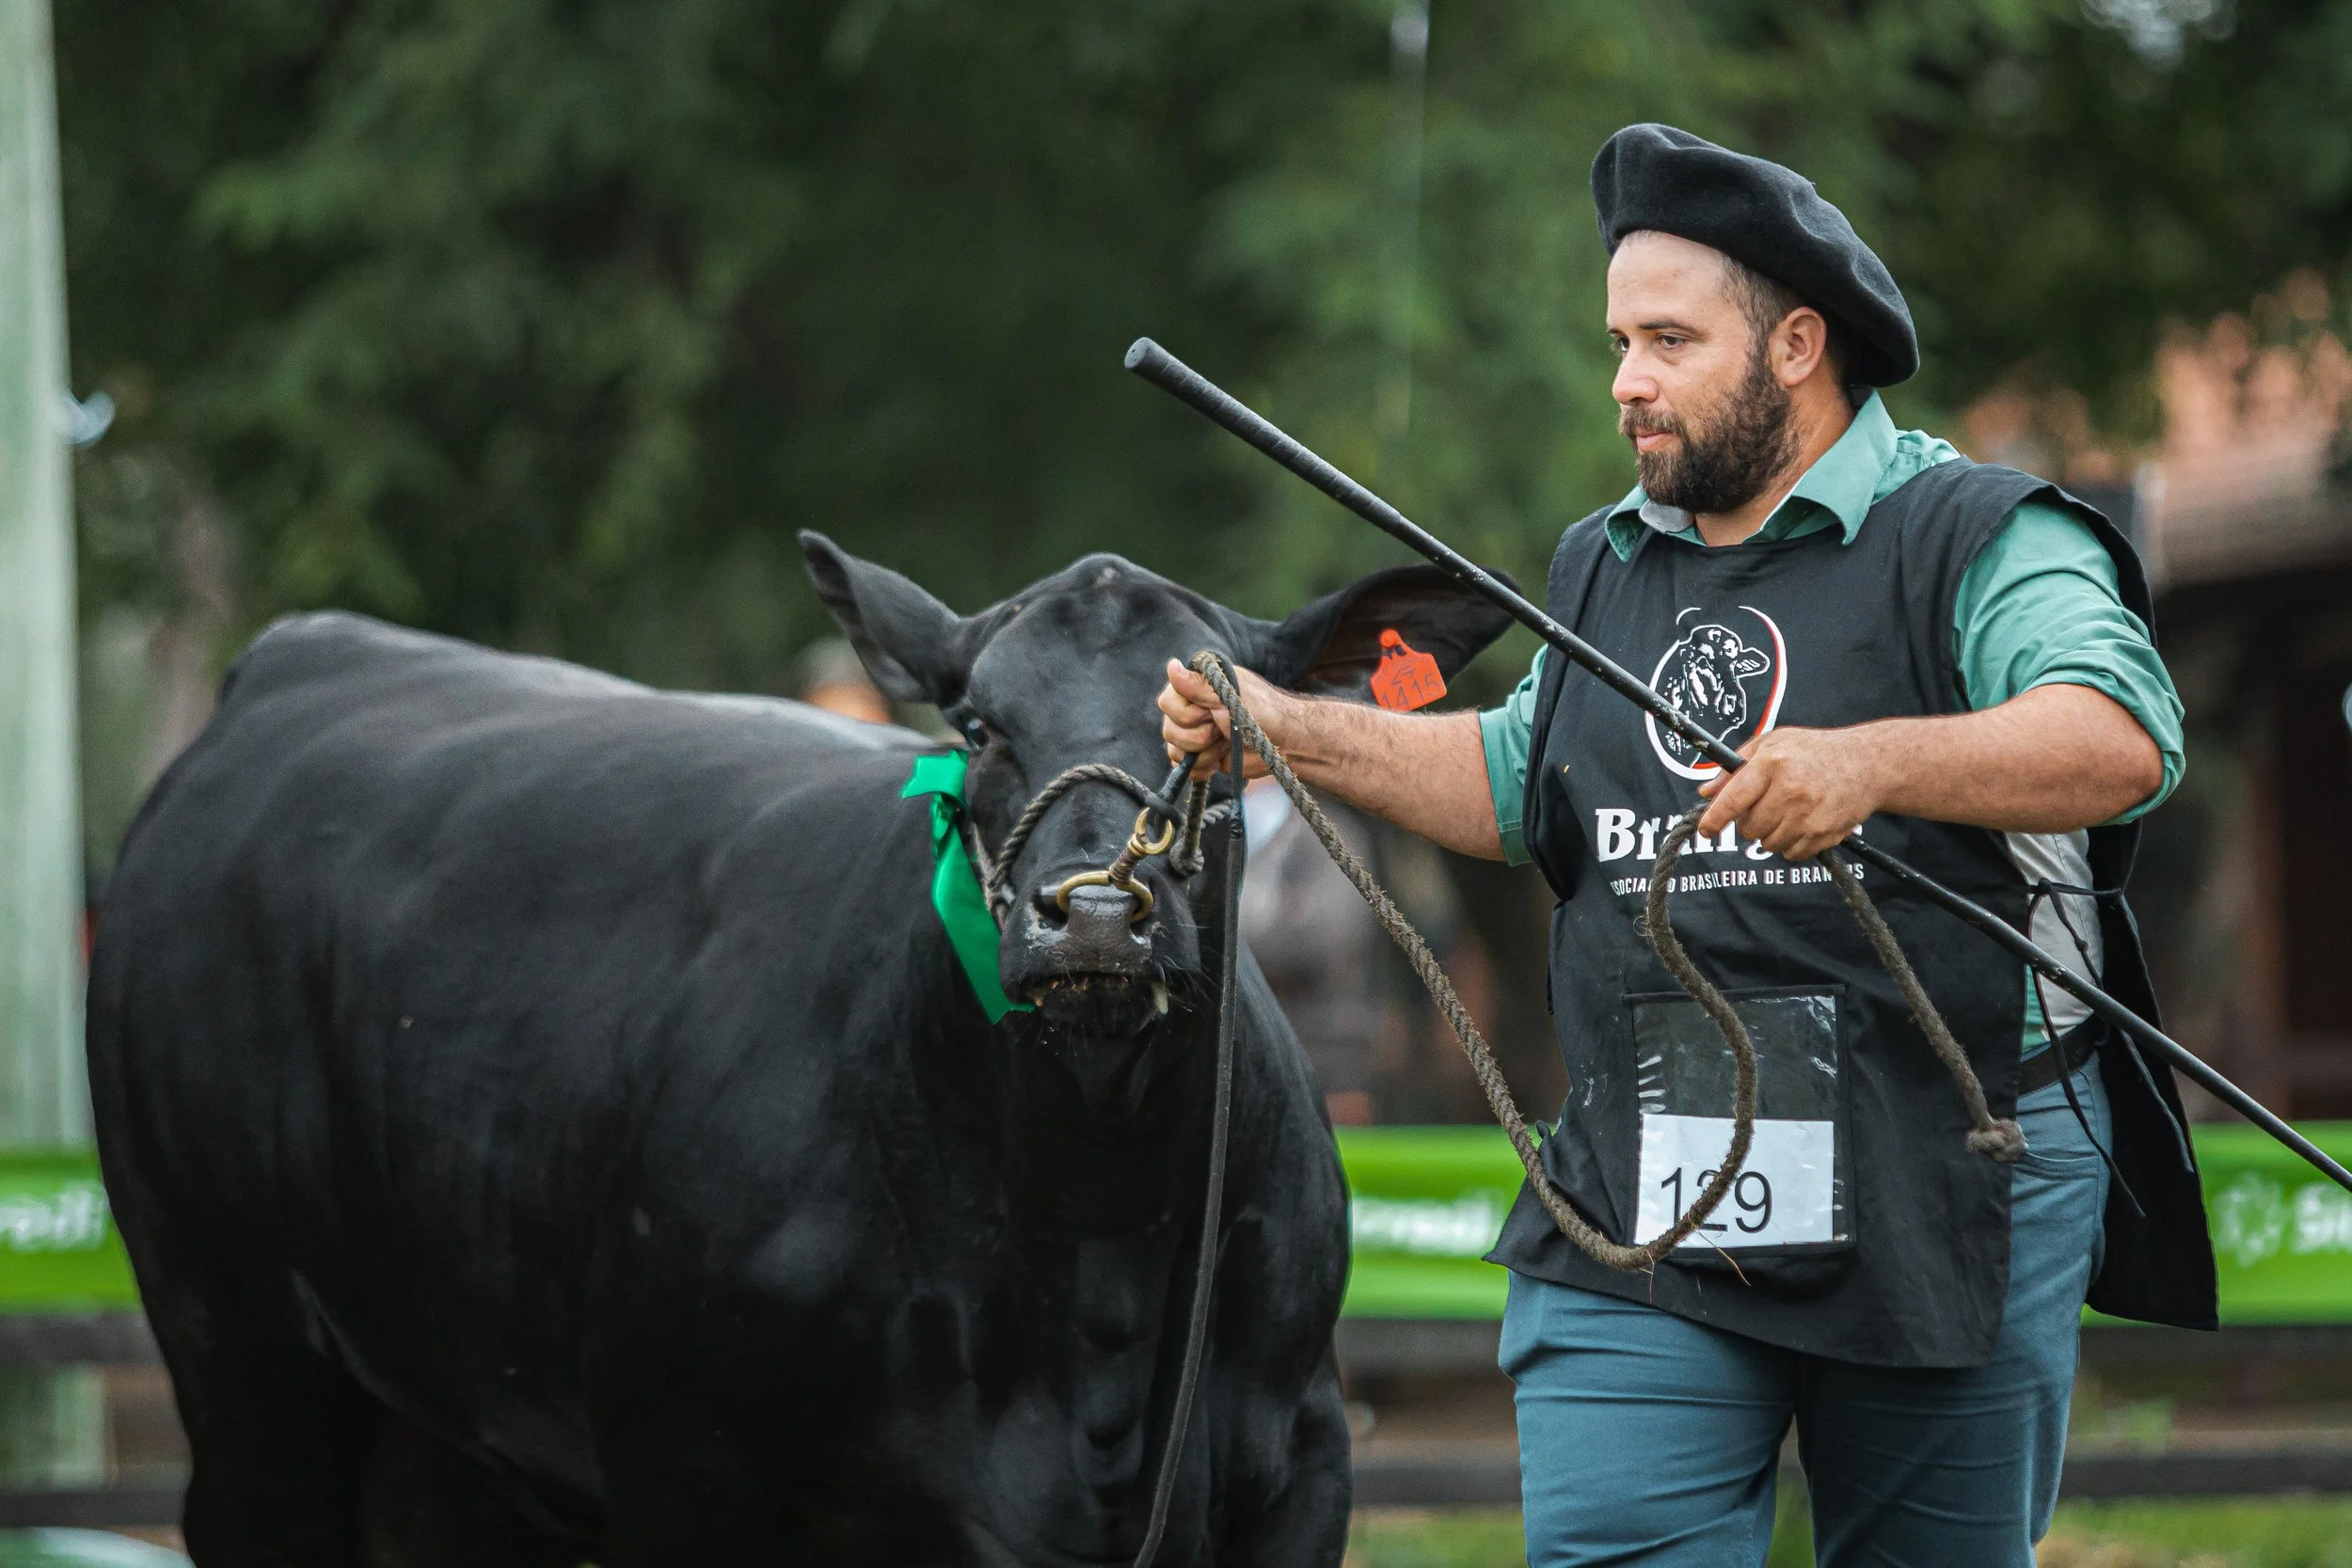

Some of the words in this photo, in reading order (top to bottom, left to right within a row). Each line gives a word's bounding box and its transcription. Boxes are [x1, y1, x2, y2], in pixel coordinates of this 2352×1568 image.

[1680, 870, 1758, 893] BRASILEIRA
[1764, 869, 1785, 885] DE
[1790, 863, 1865, 884] BRANS
